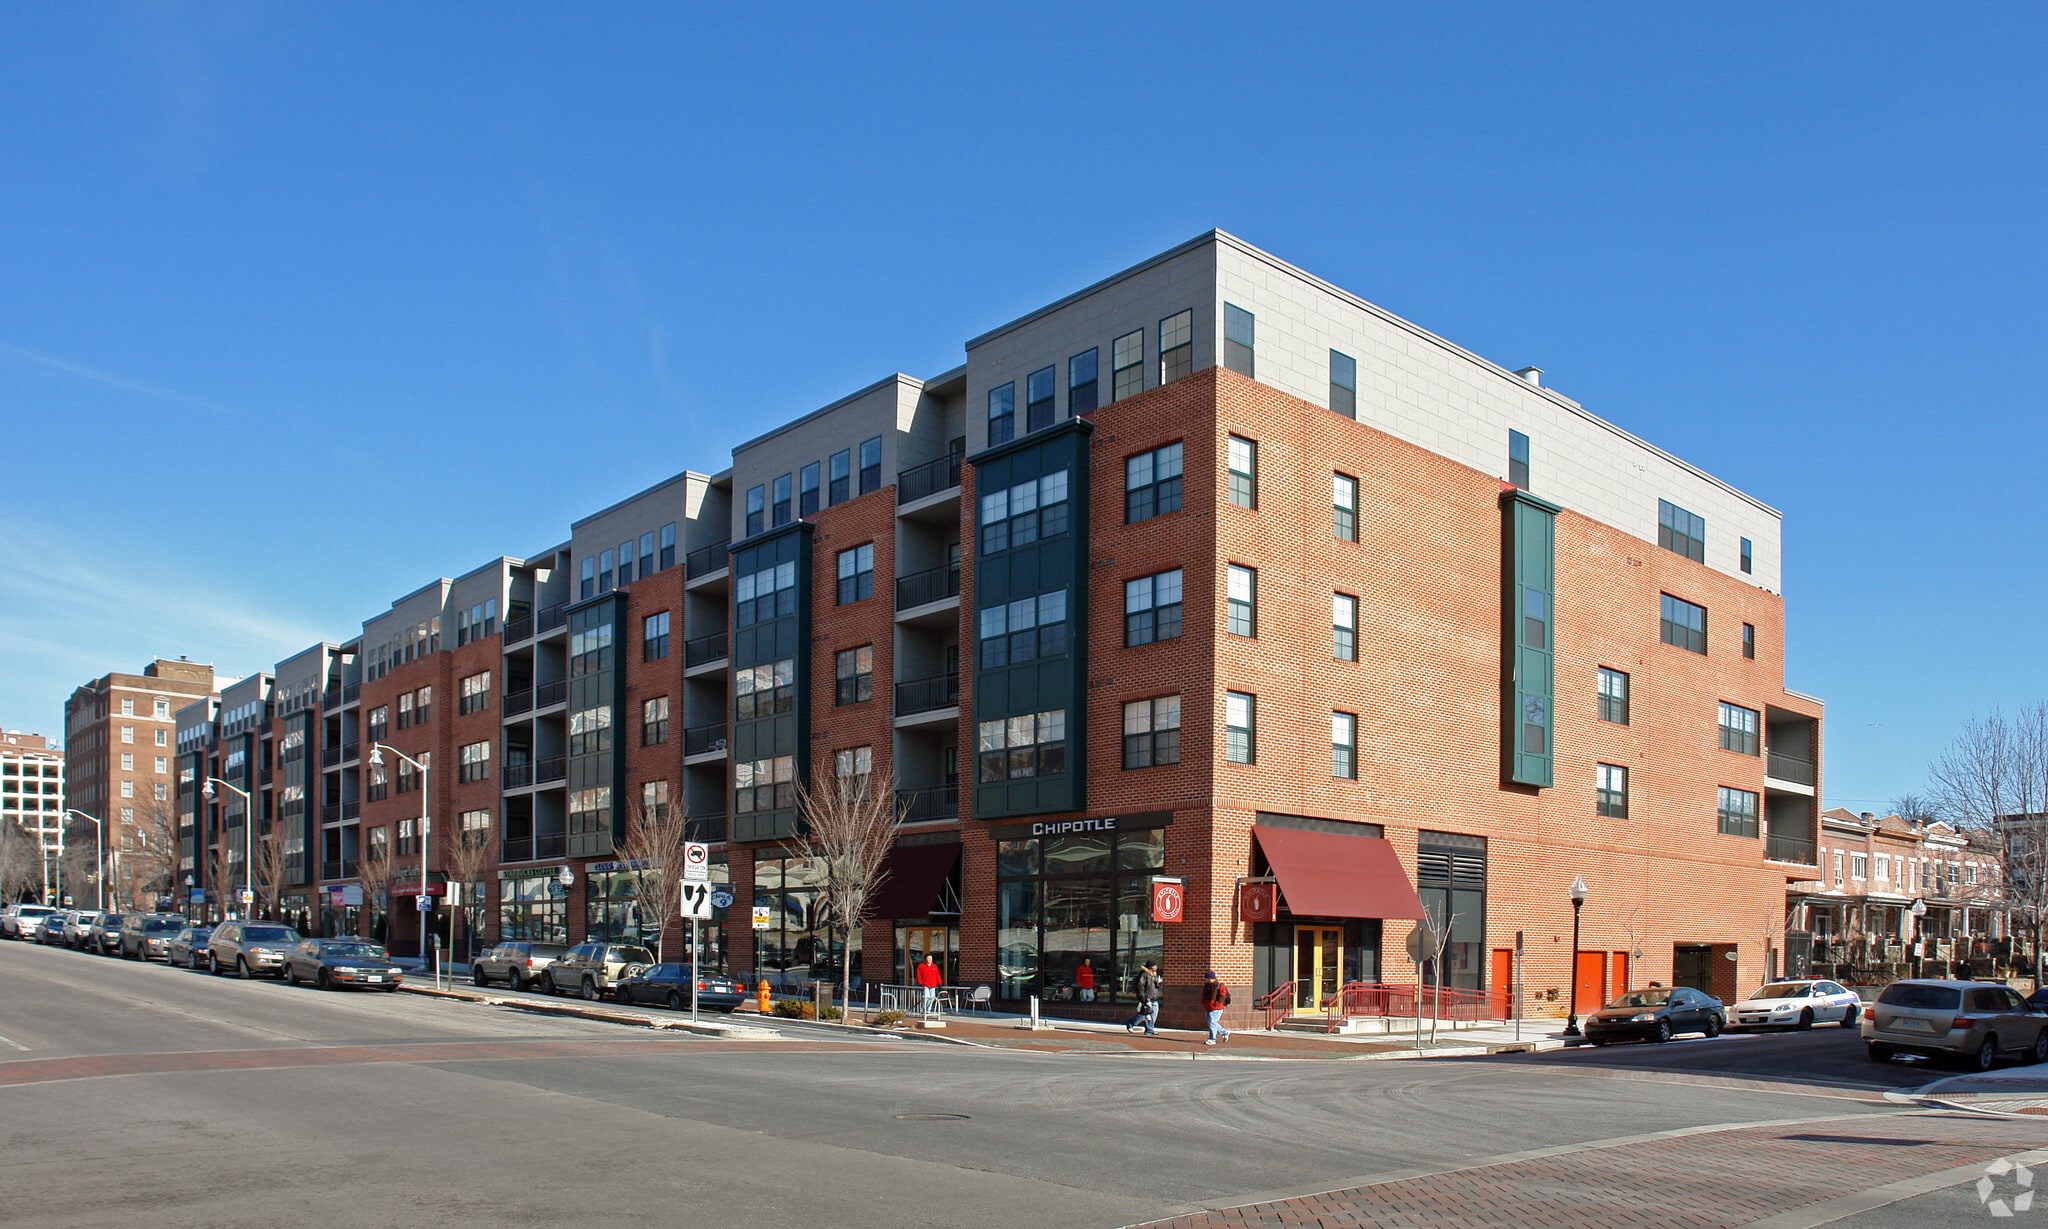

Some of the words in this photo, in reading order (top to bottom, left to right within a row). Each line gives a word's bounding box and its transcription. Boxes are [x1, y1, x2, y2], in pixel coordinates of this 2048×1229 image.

[1032, 818, 1116, 835] CHIPOTLE
[503, 868, 534, 878] STARBUCKS
[535, 866, 557, 876] COFFEE
